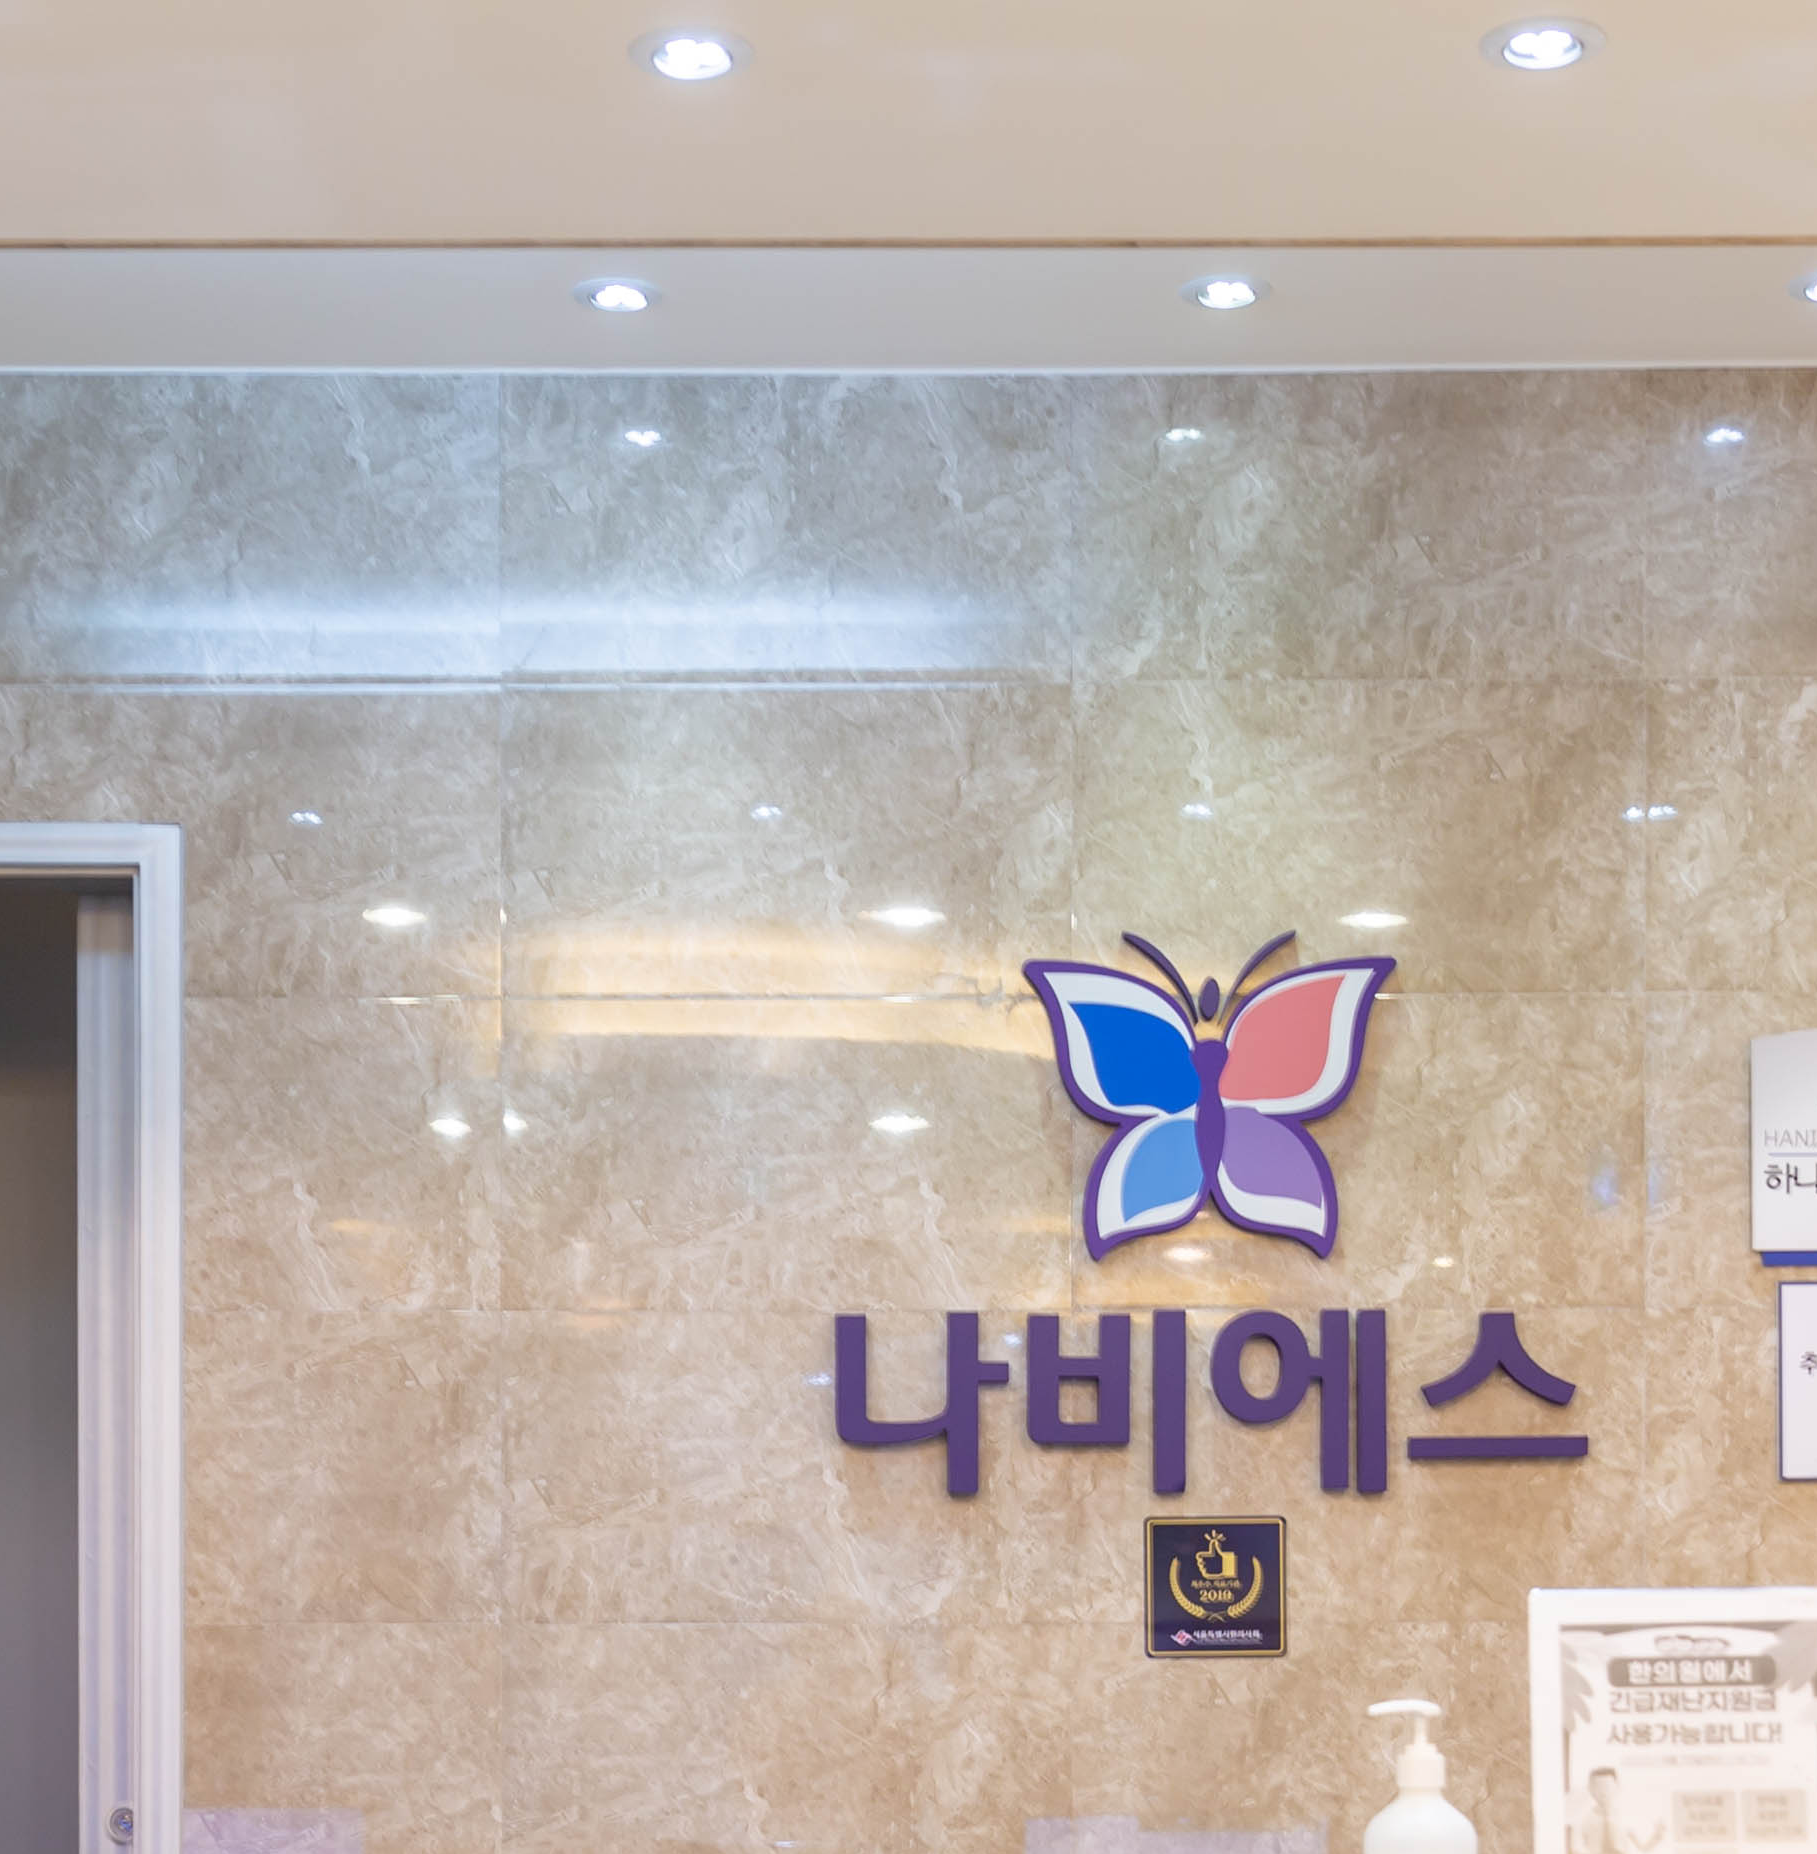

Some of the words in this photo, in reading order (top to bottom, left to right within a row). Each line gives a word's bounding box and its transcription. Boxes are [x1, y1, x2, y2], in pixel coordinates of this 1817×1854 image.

[835, 1308, 1588, 1496] 나비에스
[1628, 1659, 1753, 1684] 한의원에서
[1609, 1689, 1778, 1713] 긴급재난지원금
